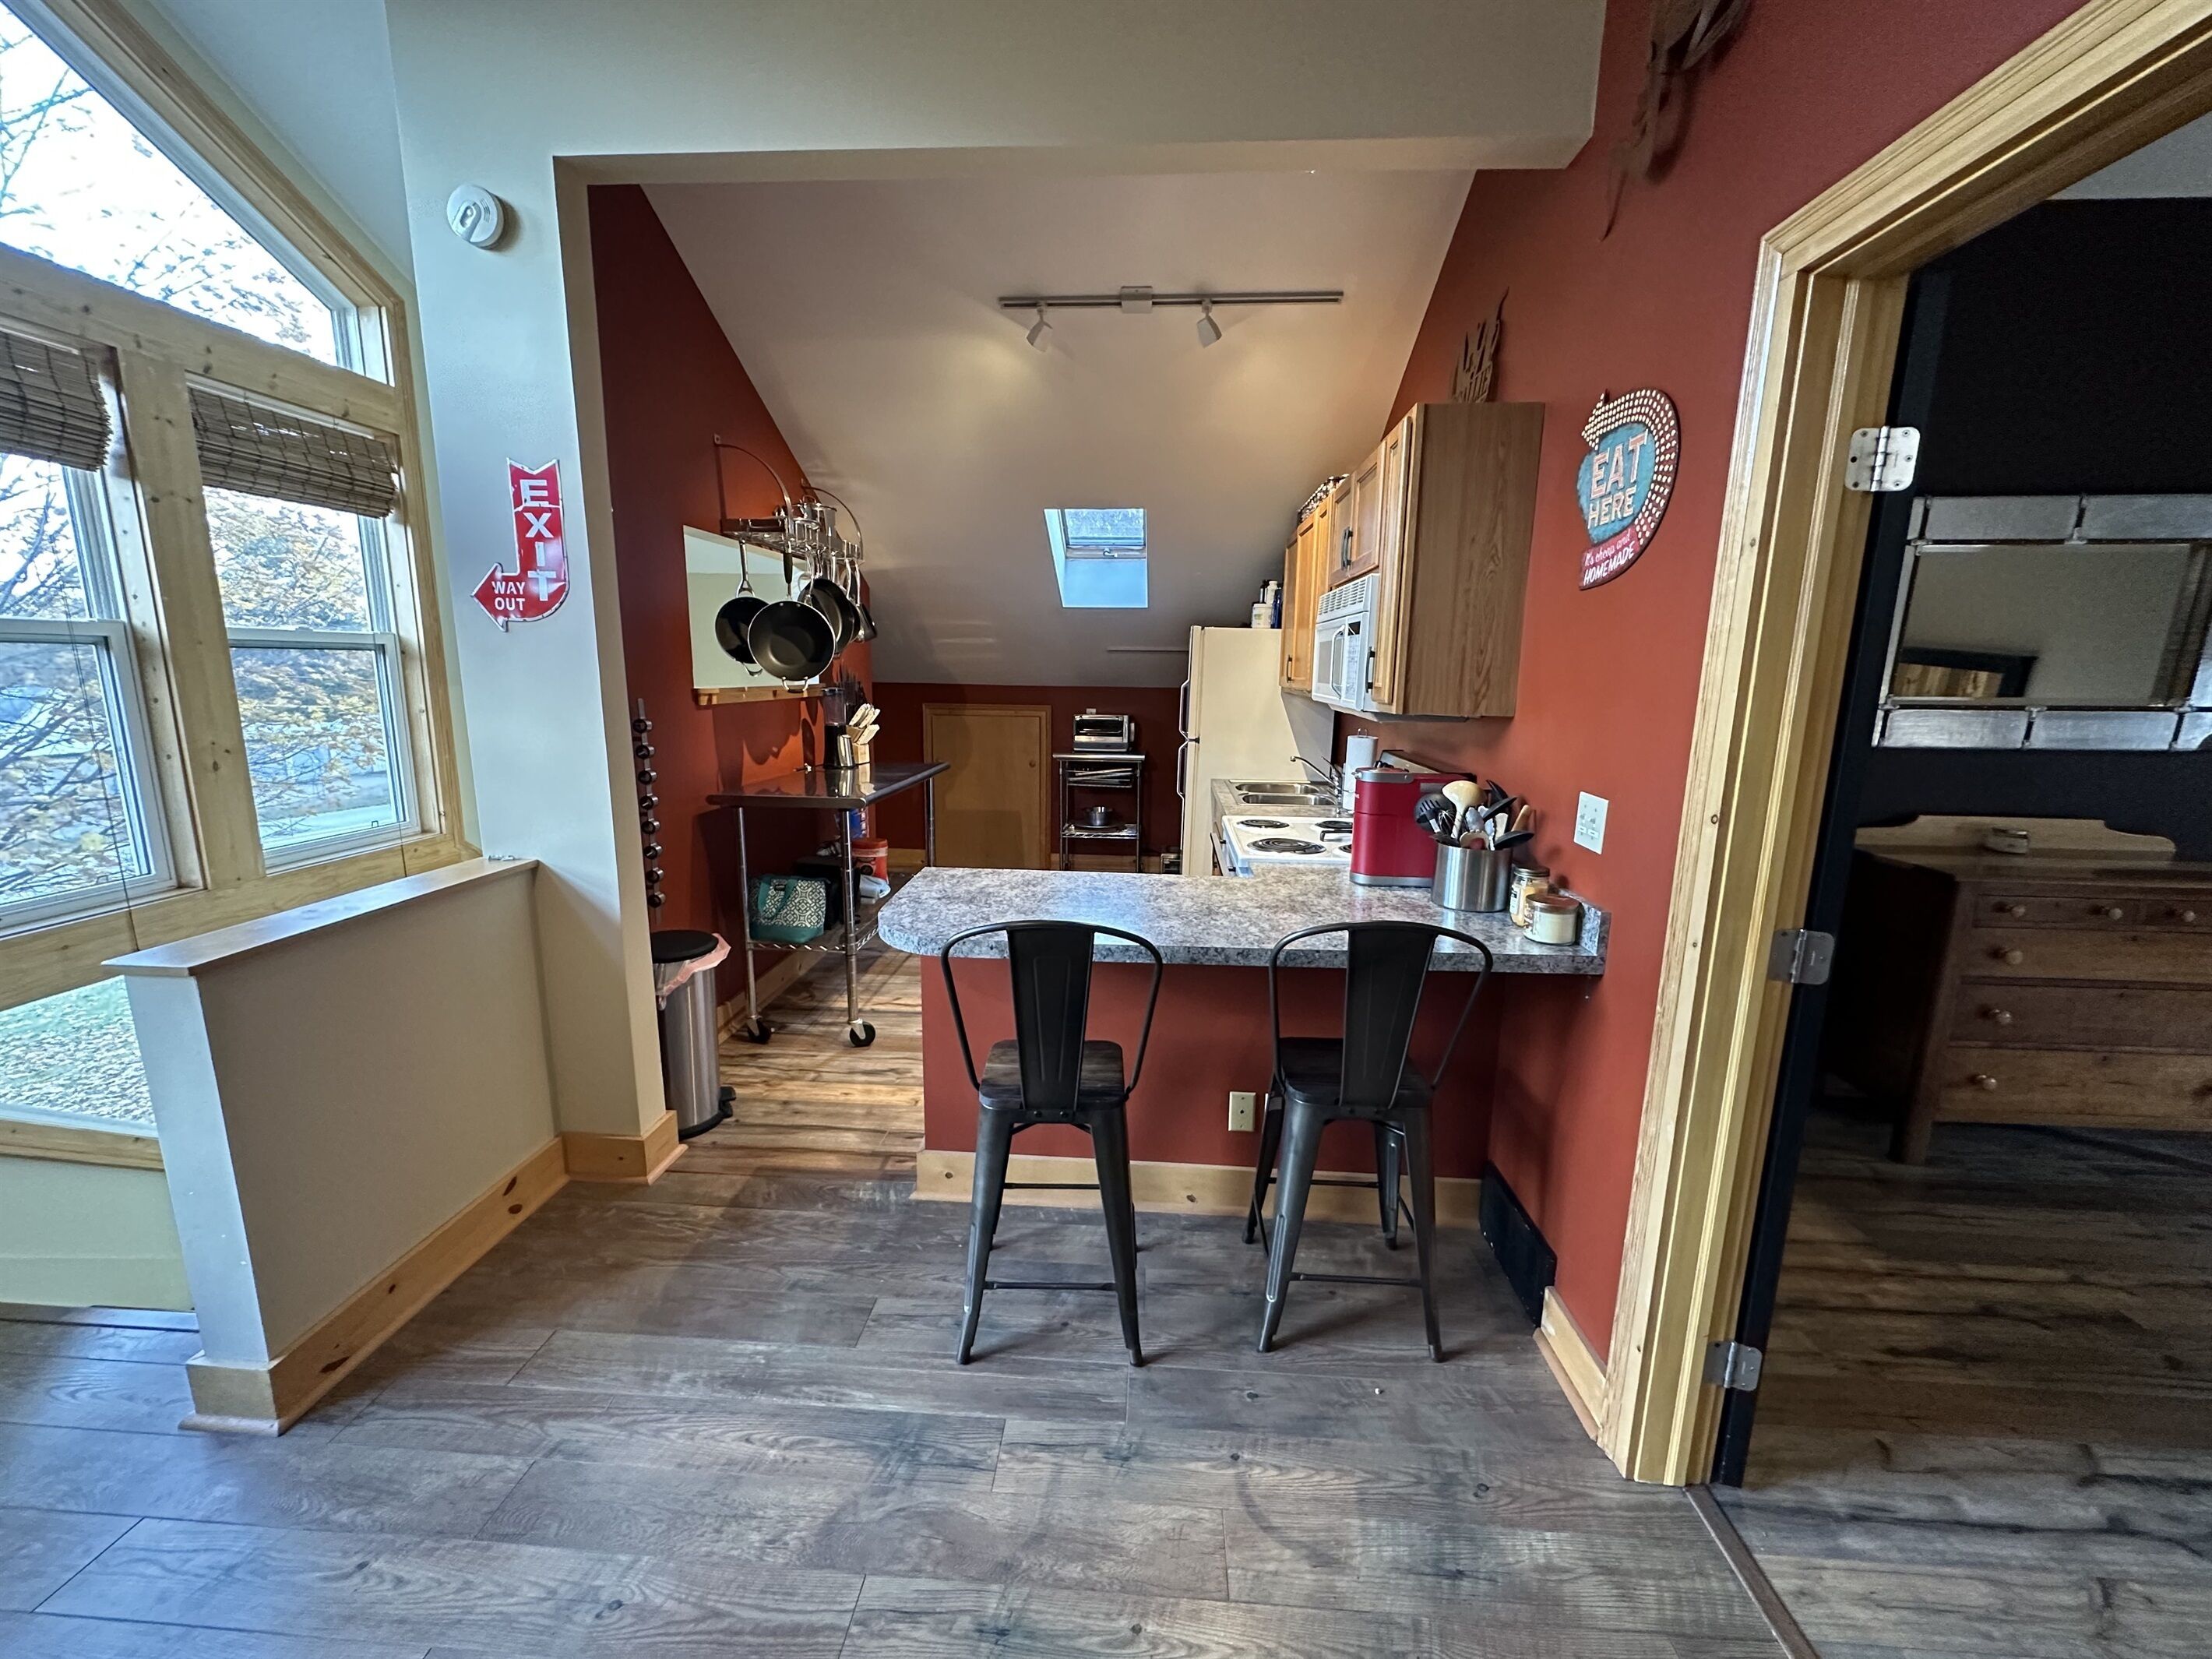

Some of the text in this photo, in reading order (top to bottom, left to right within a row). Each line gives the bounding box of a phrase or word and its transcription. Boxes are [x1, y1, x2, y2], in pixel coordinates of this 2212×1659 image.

[1590, 428, 1648, 499] EAT
[1588, 484, 1636, 530] HERE
[520, 479, 556, 601] EXIT
[1595, 547, 1615, 562] cheap
[1616, 528, 1631, 550] and
[1583, 541, 1635, 586] HOMEMADE
[491, 581, 526, 594] WAY
[495, 597, 526, 611] OUT
